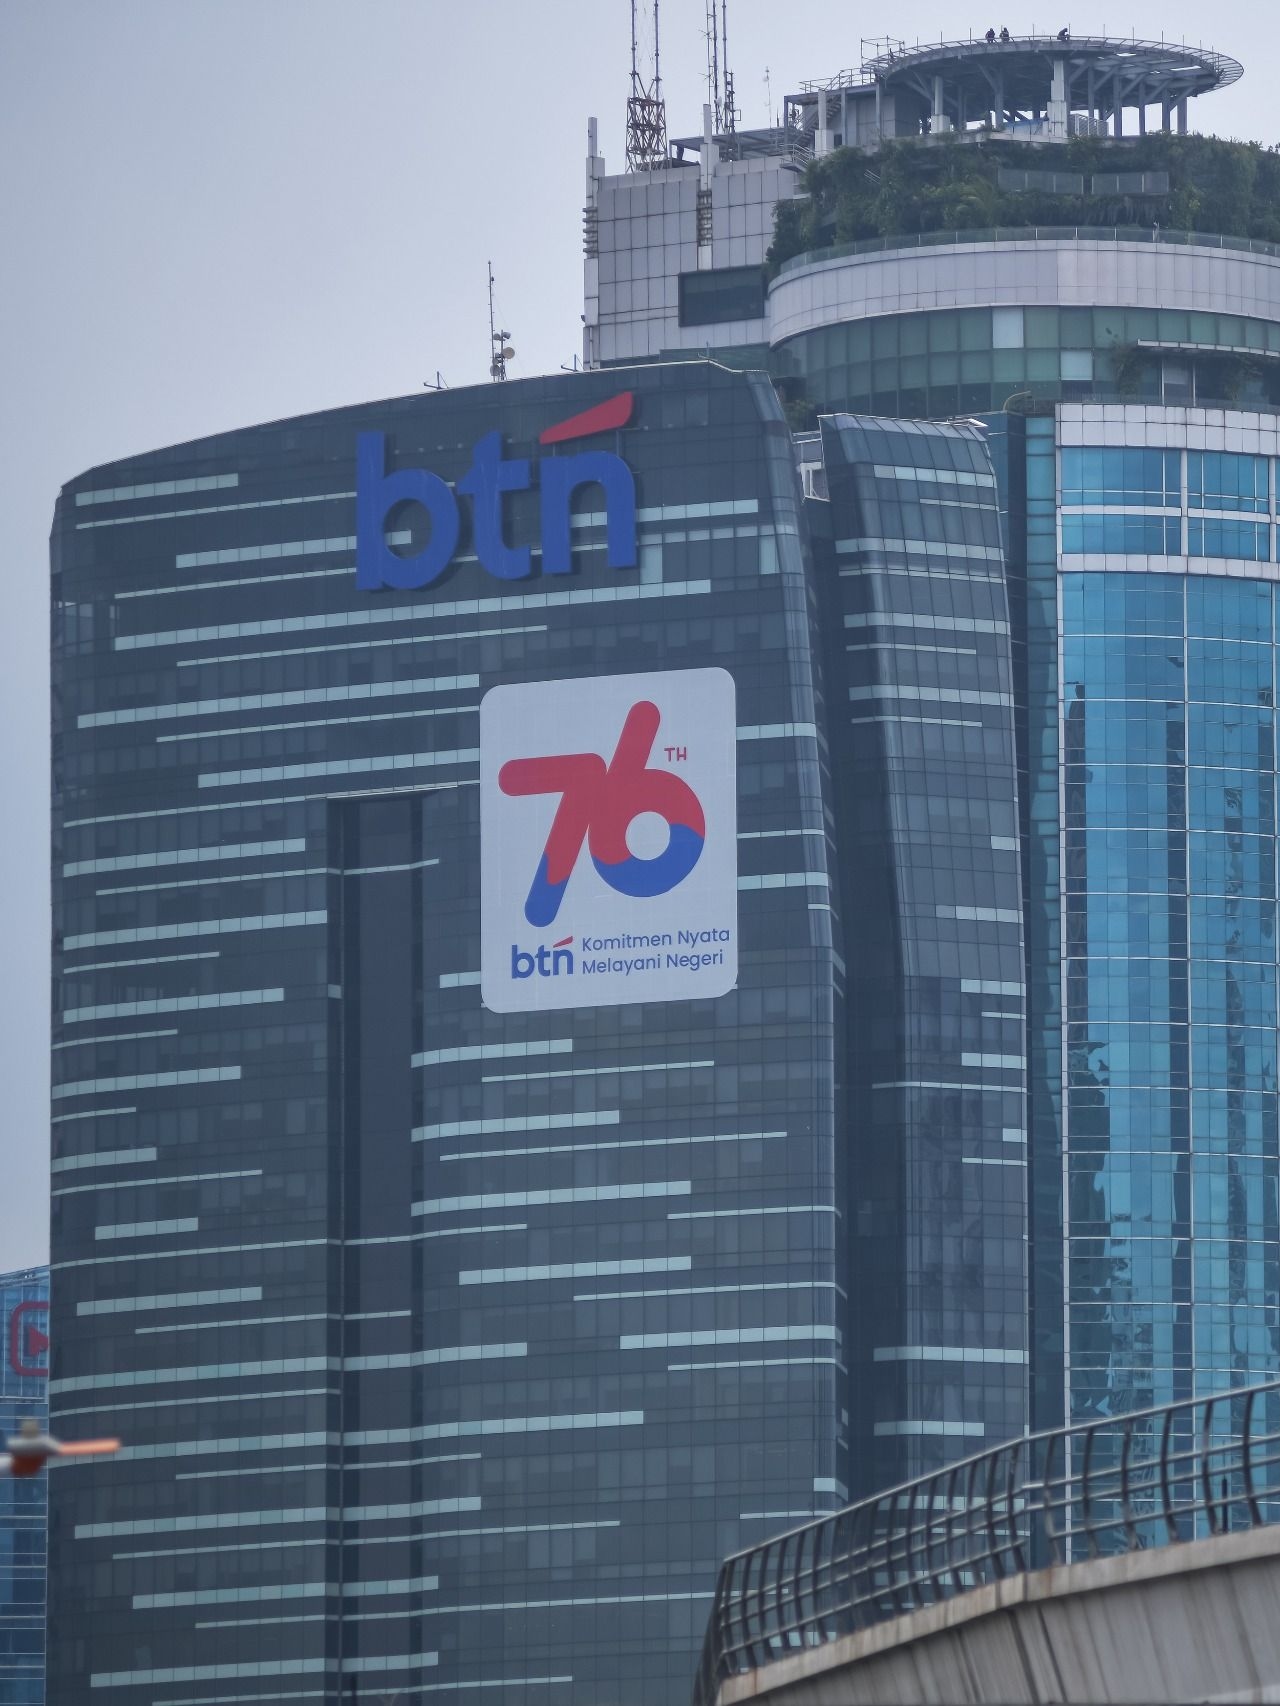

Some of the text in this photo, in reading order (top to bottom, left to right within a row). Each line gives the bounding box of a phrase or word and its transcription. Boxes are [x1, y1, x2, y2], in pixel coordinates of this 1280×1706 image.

[356, 391, 637, 591] btn
[663, 746, 687, 762] TH
[498, 700, 706, 927] 76
[511, 935, 574, 979] btn
[582, 928, 730, 952] Komitmen Nyata
[582, 949, 723, 976] Melayani Negeri
